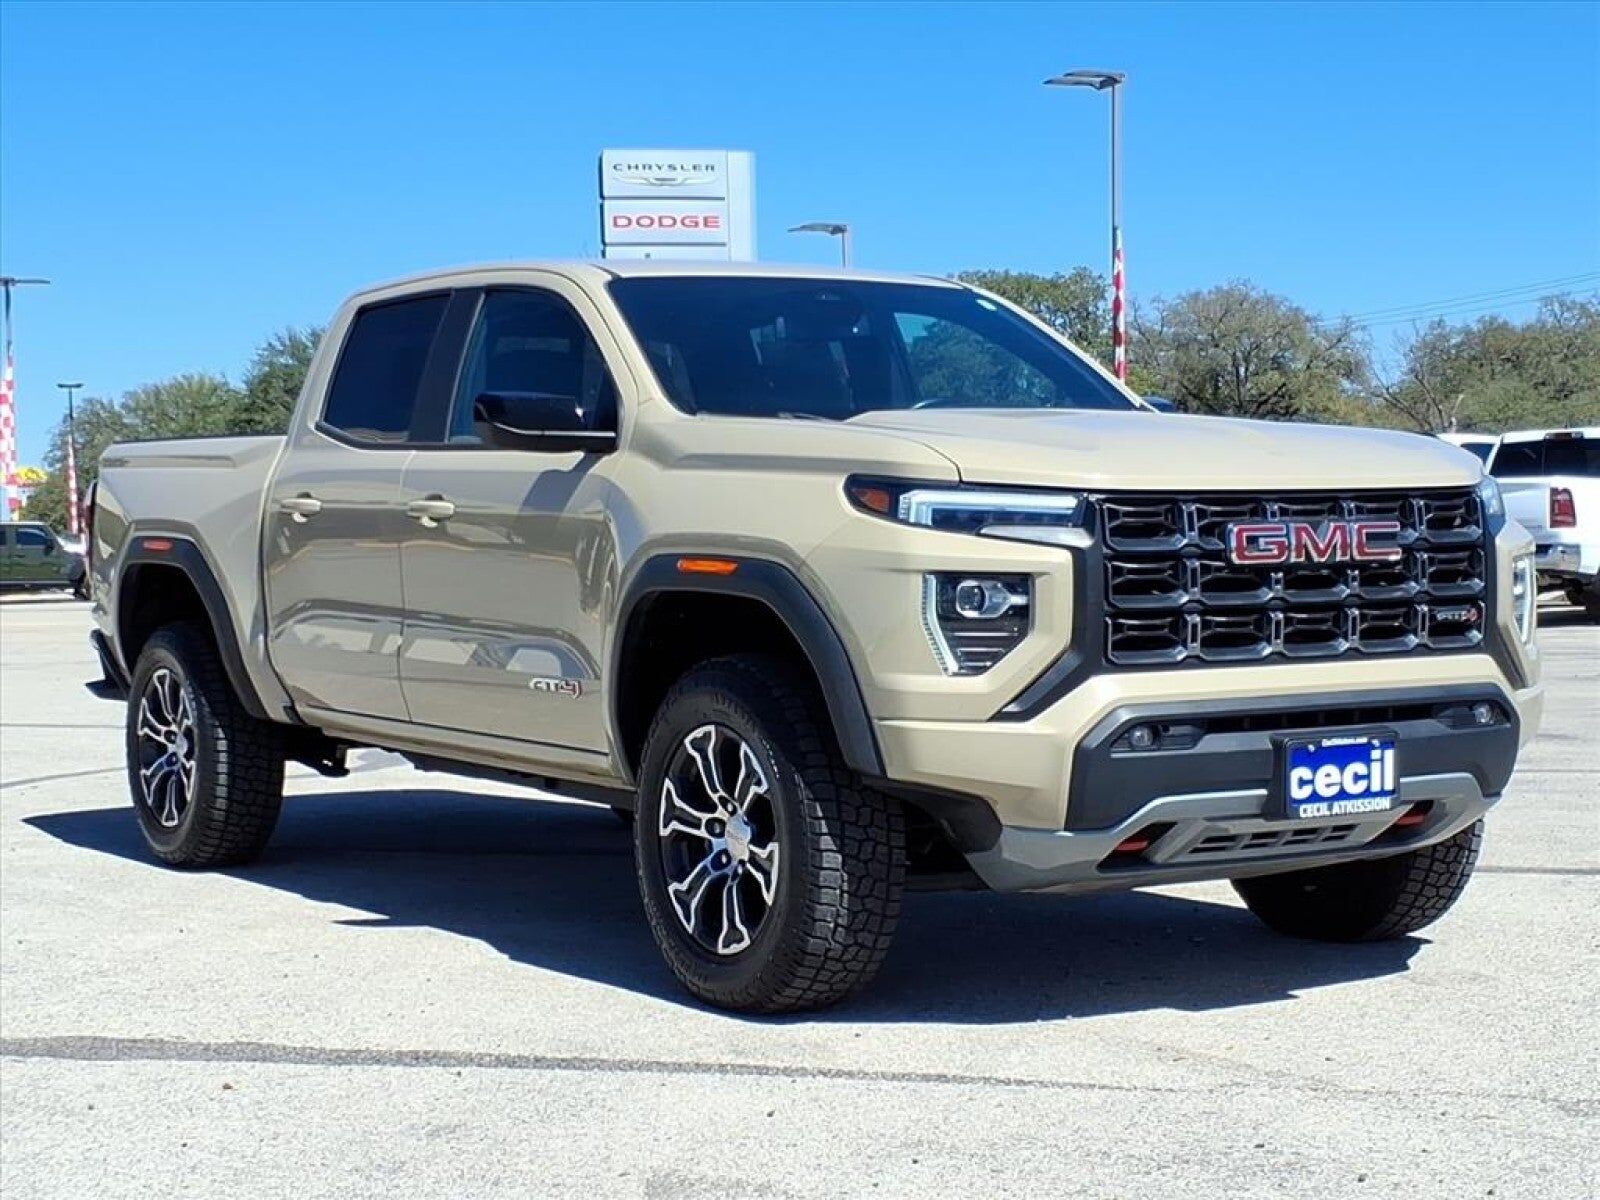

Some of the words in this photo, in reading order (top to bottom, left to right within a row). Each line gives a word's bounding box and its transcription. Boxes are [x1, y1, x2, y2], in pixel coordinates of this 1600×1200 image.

[612, 163, 715, 172] CHRYSLER
[612, 215, 720, 228] DODGE
[1229, 521, 1402, 564] GMC
[1290, 748, 1395, 800] cecil
[1299, 802, 1331, 818] CECIL
[1332, 796, 1391, 815] ATKISSION
